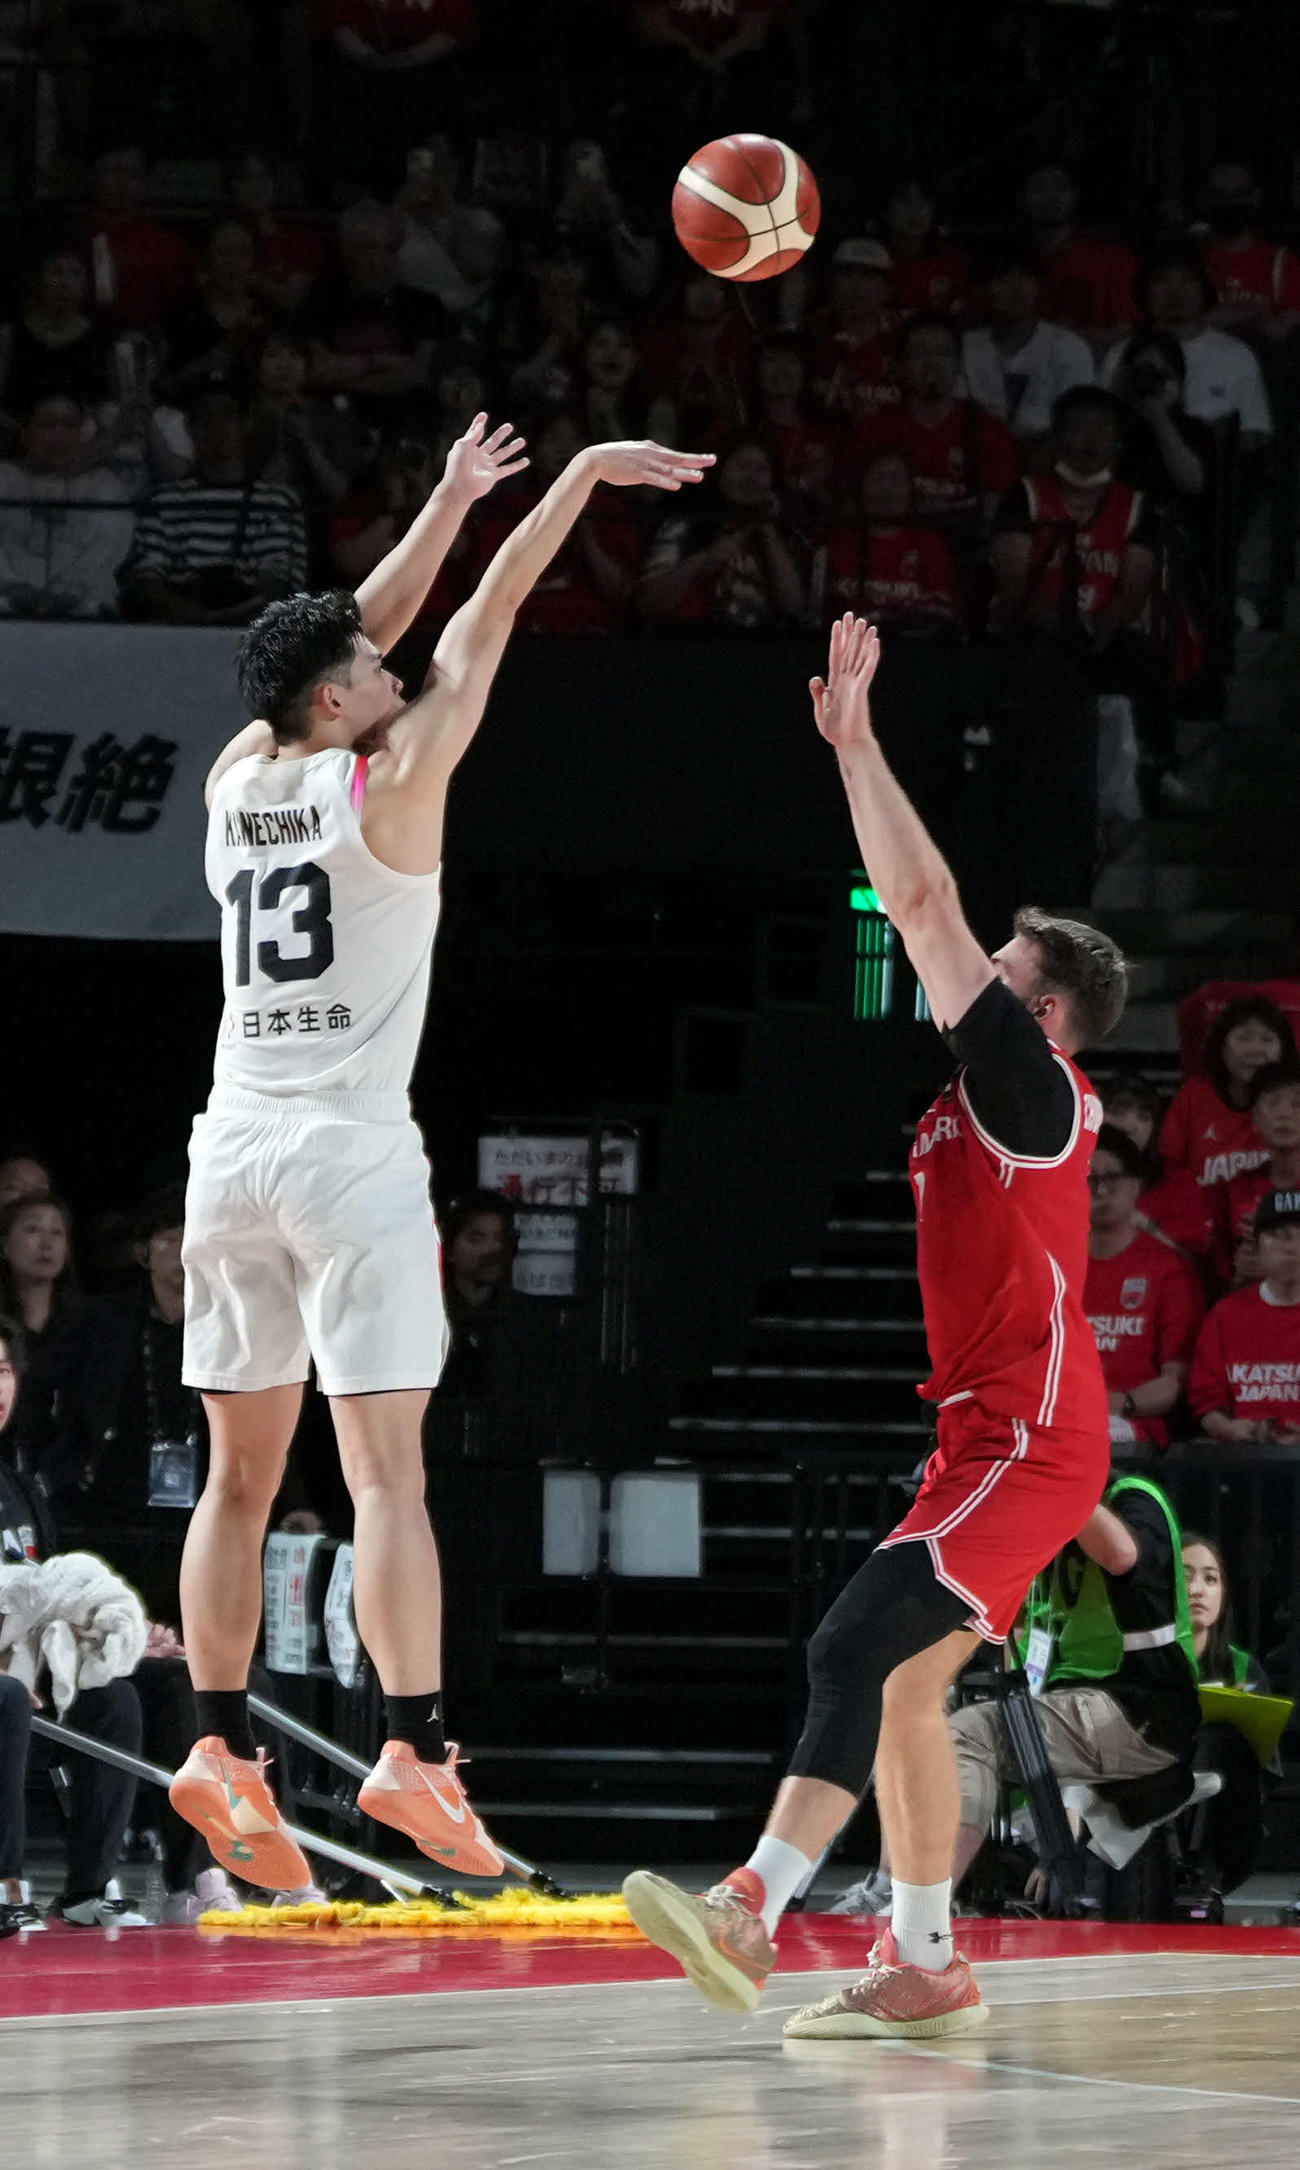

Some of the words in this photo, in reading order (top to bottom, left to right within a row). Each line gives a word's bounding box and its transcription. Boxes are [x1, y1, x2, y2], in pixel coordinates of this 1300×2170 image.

[225, 861, 334, 987] 13
[243, 1003, 352, 1038] 日本生命
